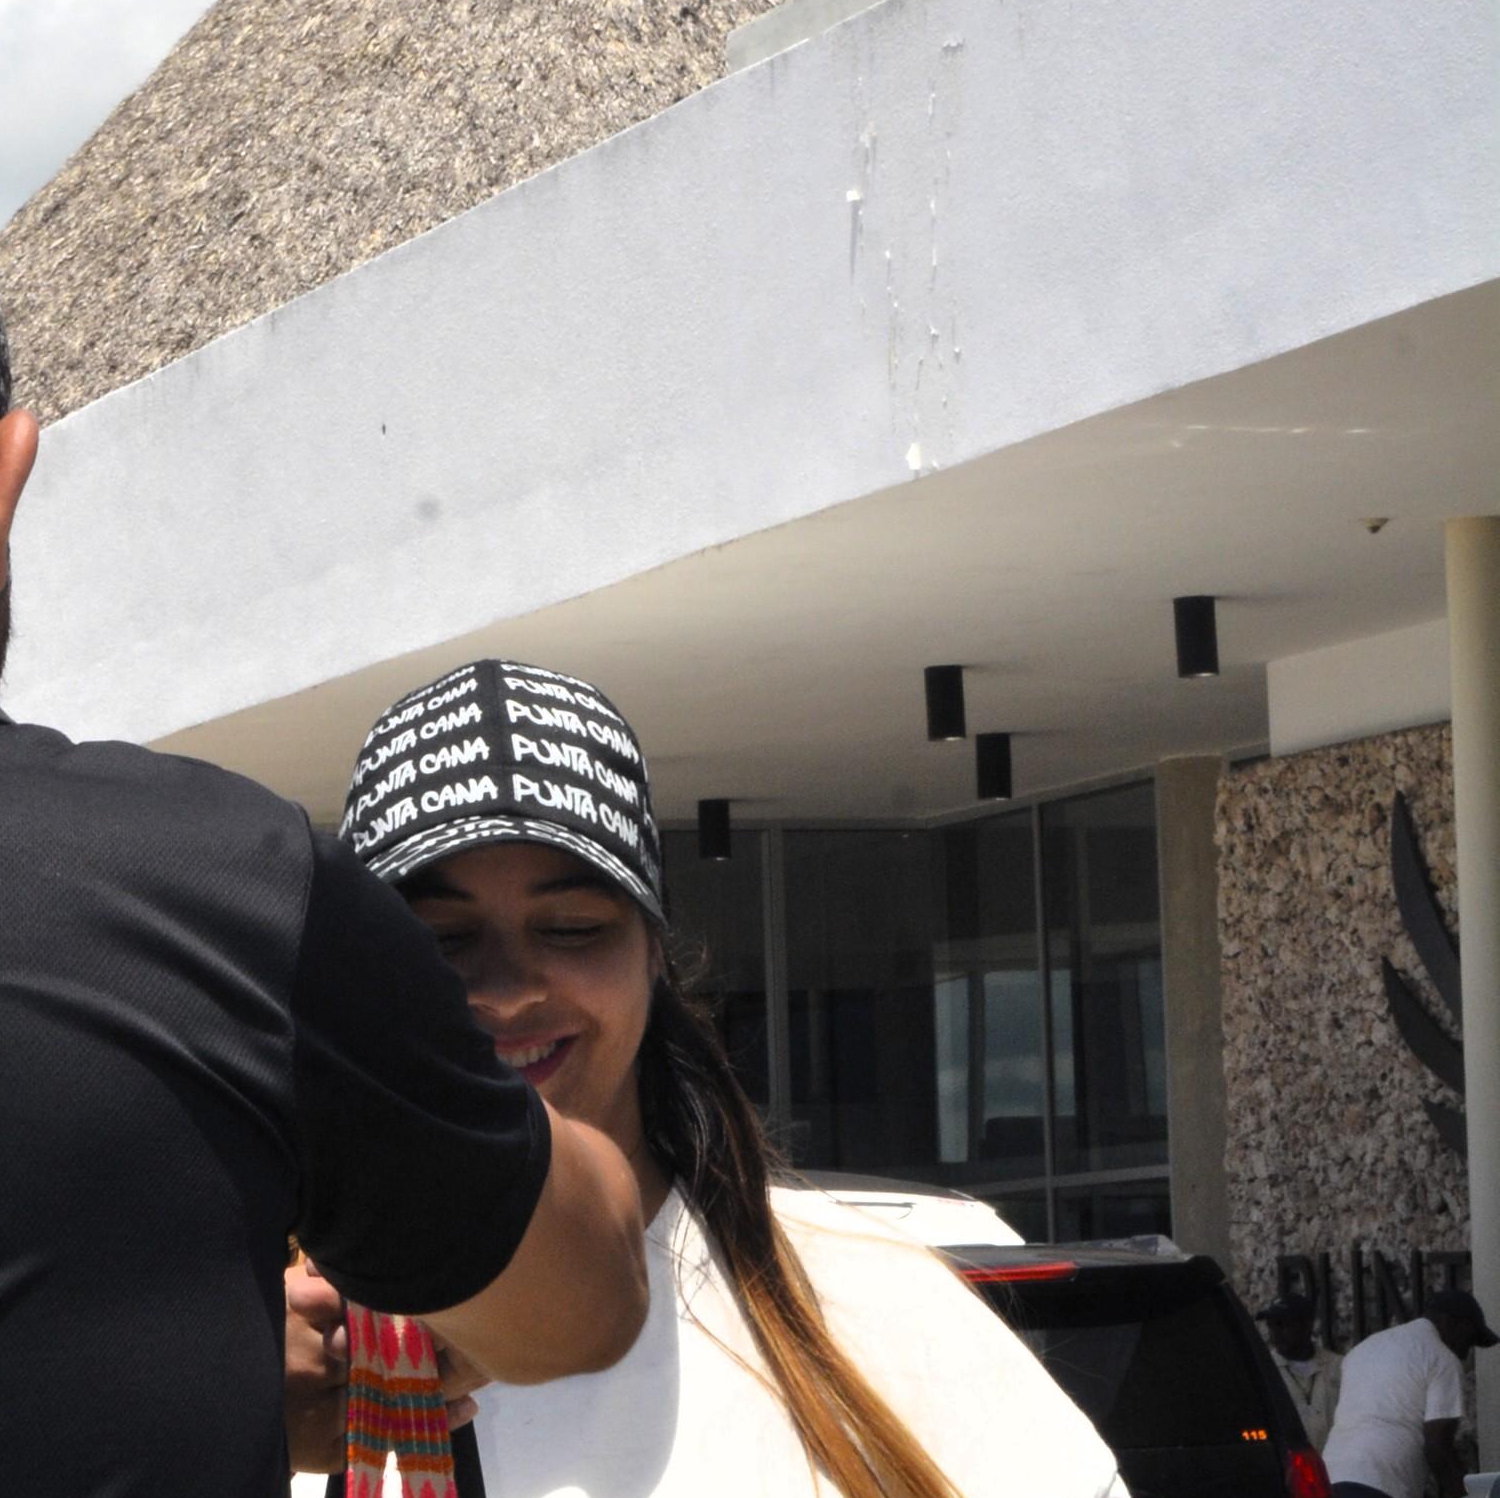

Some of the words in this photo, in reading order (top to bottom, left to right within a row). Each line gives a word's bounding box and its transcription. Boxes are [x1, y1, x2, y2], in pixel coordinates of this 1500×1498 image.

[427, 678, 479, 710] CANA
[504, 677, 576, 704] PUNTA
[359, 728, 418, 778] PUNTA
[420, 702, 483, 740] CANA
[505, 699, 587, 738] PUNTA
[586, 720, 640, 765] CANA
[356, 760, 417, 822] PUNTA
[419, 736, 490, 774] CANA
[511, 733, 594, 780] PUNTA
[594, 760, 639, 808] CANA
[512, 773, 598, 824] PUNTA
[353, 796, 418, 854] PUNTA
[421, 775, 498, 813] CANA
[1242, 1431, 1268, 1441] 115
